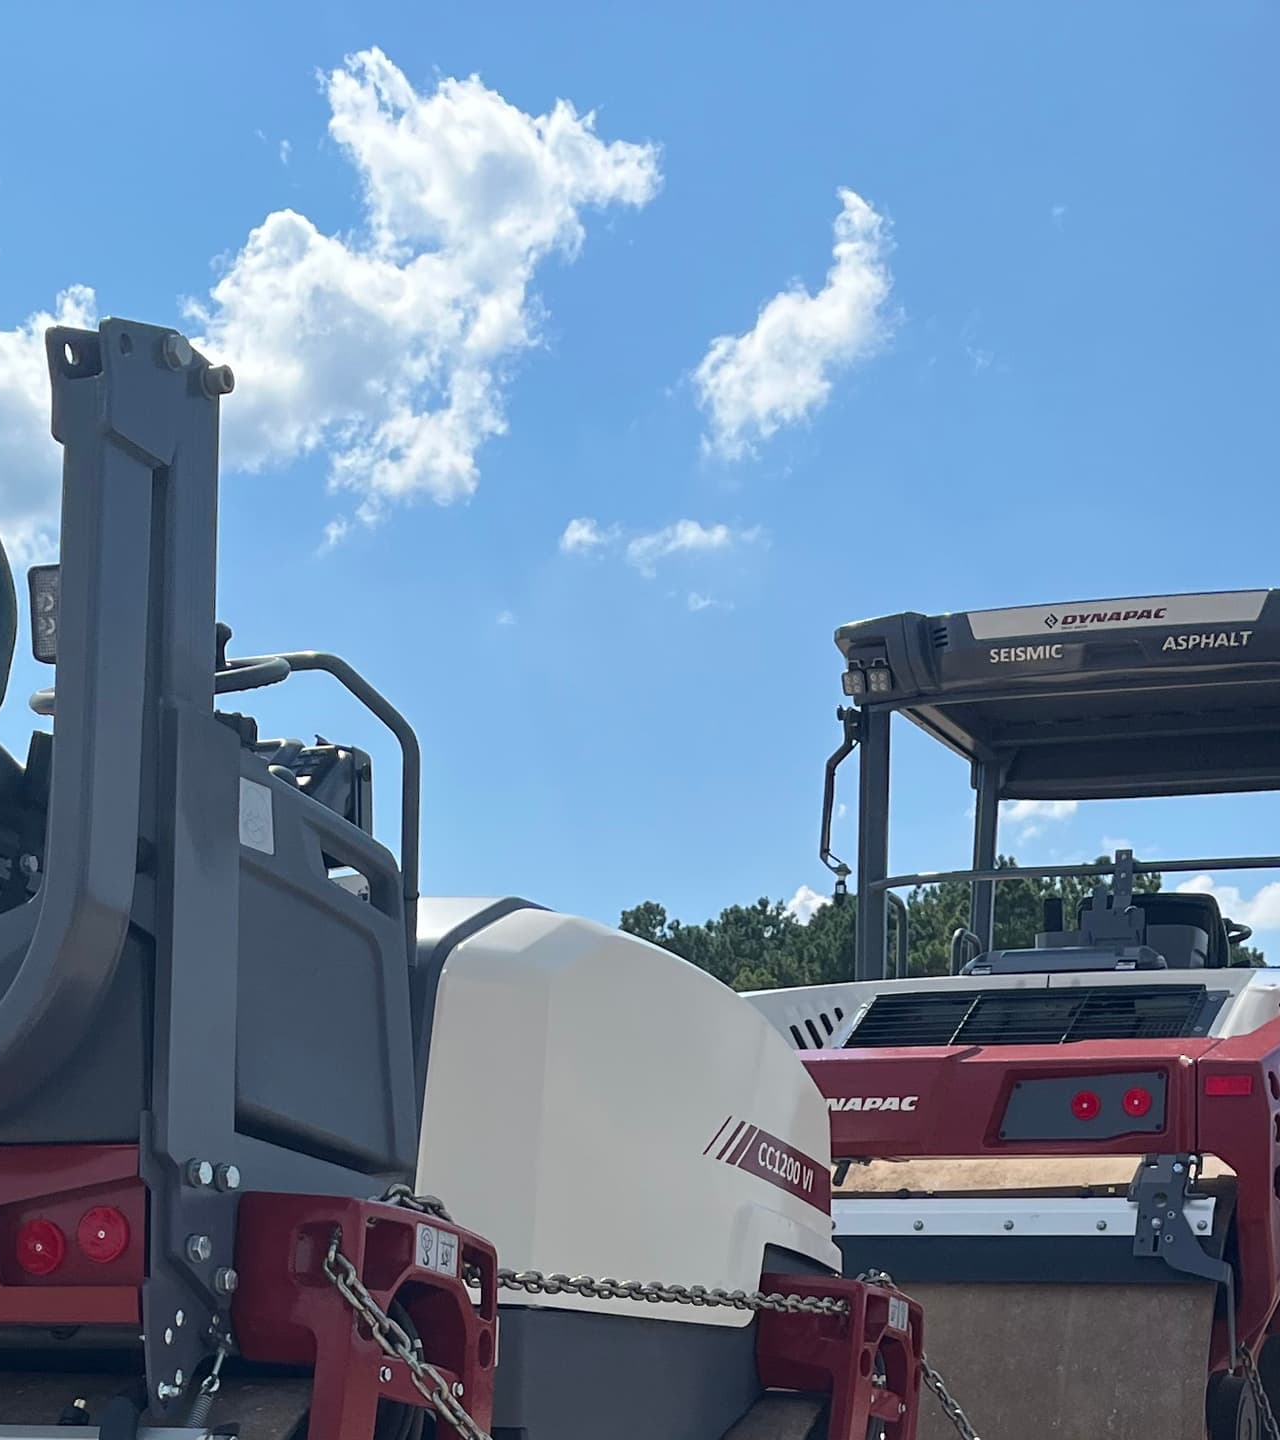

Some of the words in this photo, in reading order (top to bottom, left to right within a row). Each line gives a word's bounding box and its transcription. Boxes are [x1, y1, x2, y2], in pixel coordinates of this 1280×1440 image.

[1061, 608, 1167, 625] DYNAPAC
[989, 644, 1063, 664] SEISMIC
[1162, 631, 1252, 651] ASPHALT
[758, 1142, 801, 1185] CC1200
[802, 1164, 815, 1193] VI
